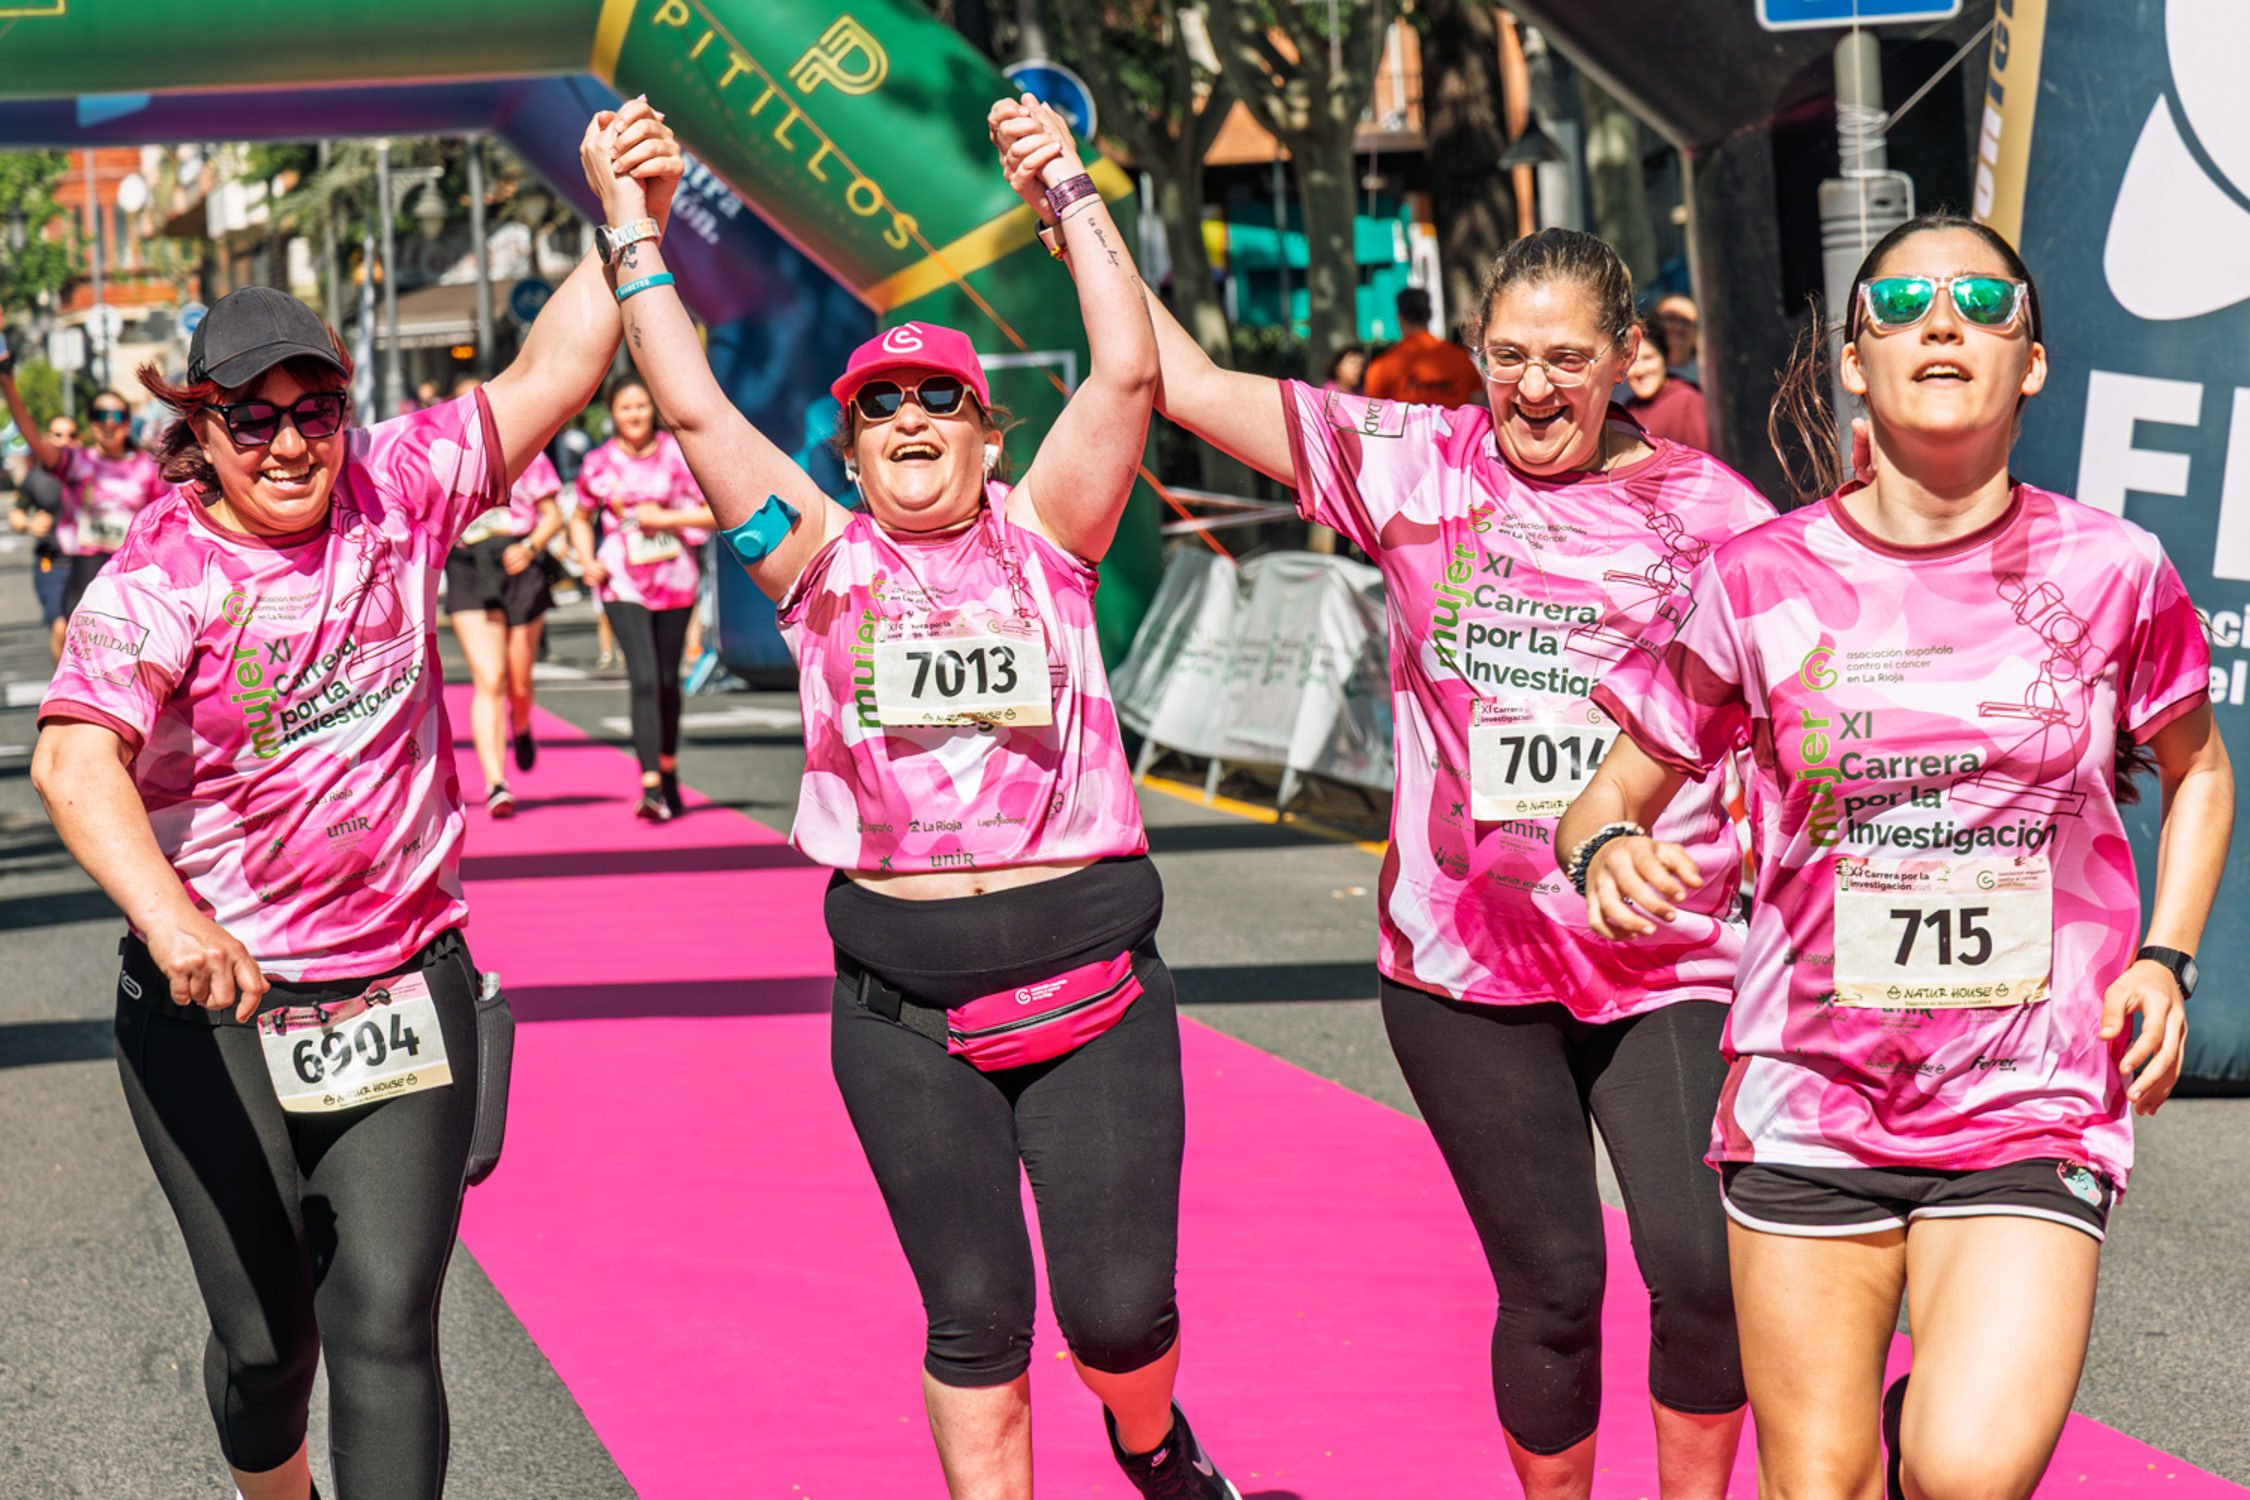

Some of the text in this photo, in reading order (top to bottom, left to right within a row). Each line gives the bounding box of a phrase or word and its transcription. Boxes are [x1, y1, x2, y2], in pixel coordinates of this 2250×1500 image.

[651, 0, 919, 249] PITILLOS
[1481, 552, 1514, 578] XI
[1432, 543, 1477, 669] mujer
[1474, 584, 1598, 625] Carrera
[264, 638, 292, 665] XI
[1466, 621, 1559, 656] por la
[273, 637, 358, 697] Carrera
[906, 645, 1018, 699] 7013
[1846, 662, 1881, 671] contra
[1847, 672, 1905, 684] en La Rioja
[231, 644, 281, 759] mujer
[279, 679, 350, 731] por la
[1838, 711, 1873, 740] XI
[1796, 709, 1843, 848] mujer
[1838, 751, 1981, 781] Carrera
[1844, 785, 1942, 818] por la
[923, 822, 935, 832] La
[936, 819, 963, 832] Rioja
[1850, 879, 1913, 892] investigación
[1864, 869, 1900, 879] Carrera
[1901, 873, 1918, 882] por
[1919, 871, 1930, 880] la
[1890, 906, 1994, 967] 715
[1904, 986, 1993, 999] NATUR HOUSE
[292, 1013, 421, 1084] 6904
[1970, 1055, 2018, 1069] Ferrer
